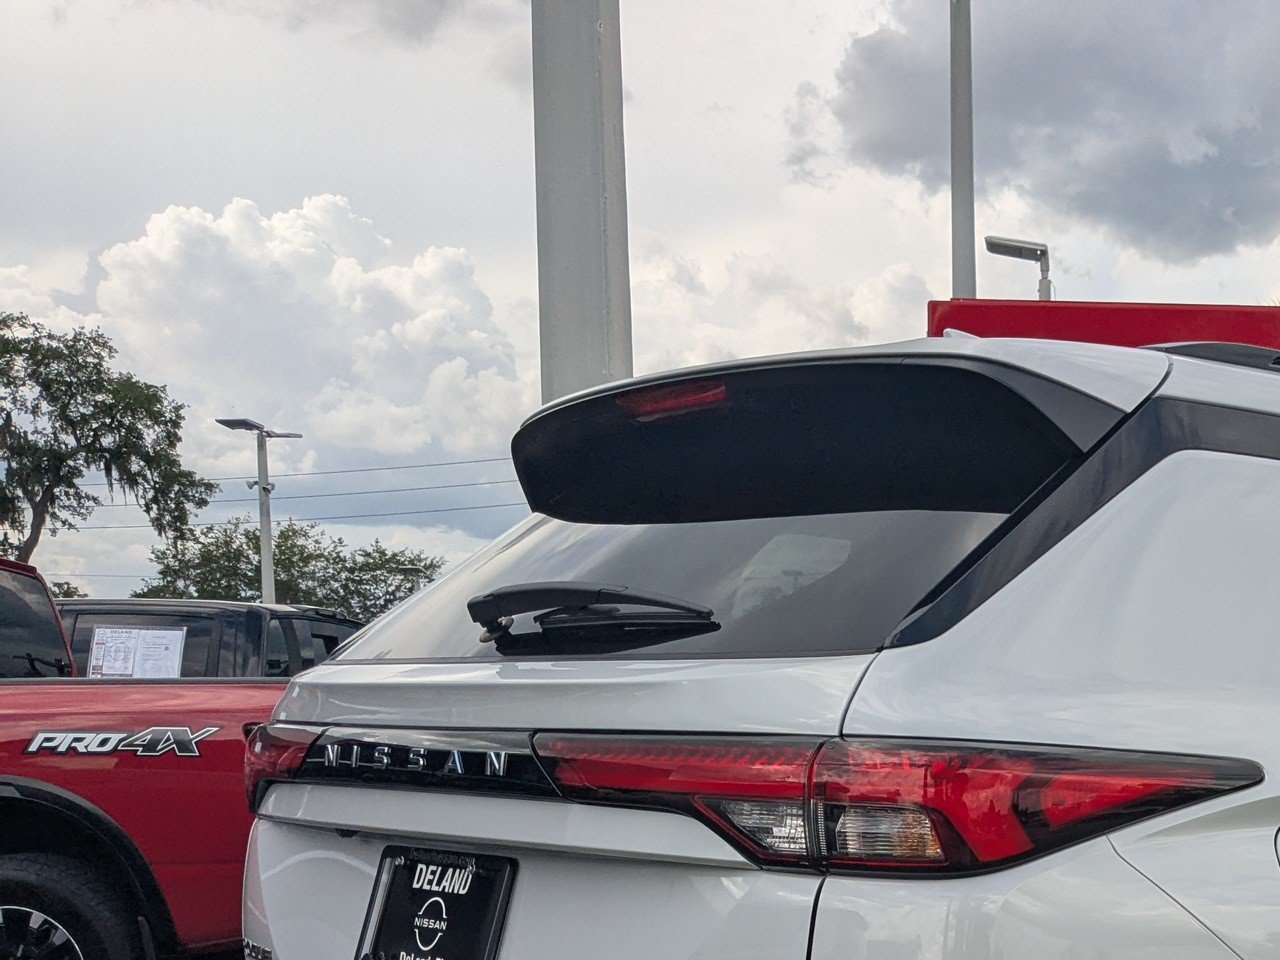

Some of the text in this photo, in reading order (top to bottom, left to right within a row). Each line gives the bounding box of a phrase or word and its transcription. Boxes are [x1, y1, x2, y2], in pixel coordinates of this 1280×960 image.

[325, 744, 508, 776] NISSAN
[412, 863, 473, 895] DELAND
[414, 917, 447, 930] NISSAN
